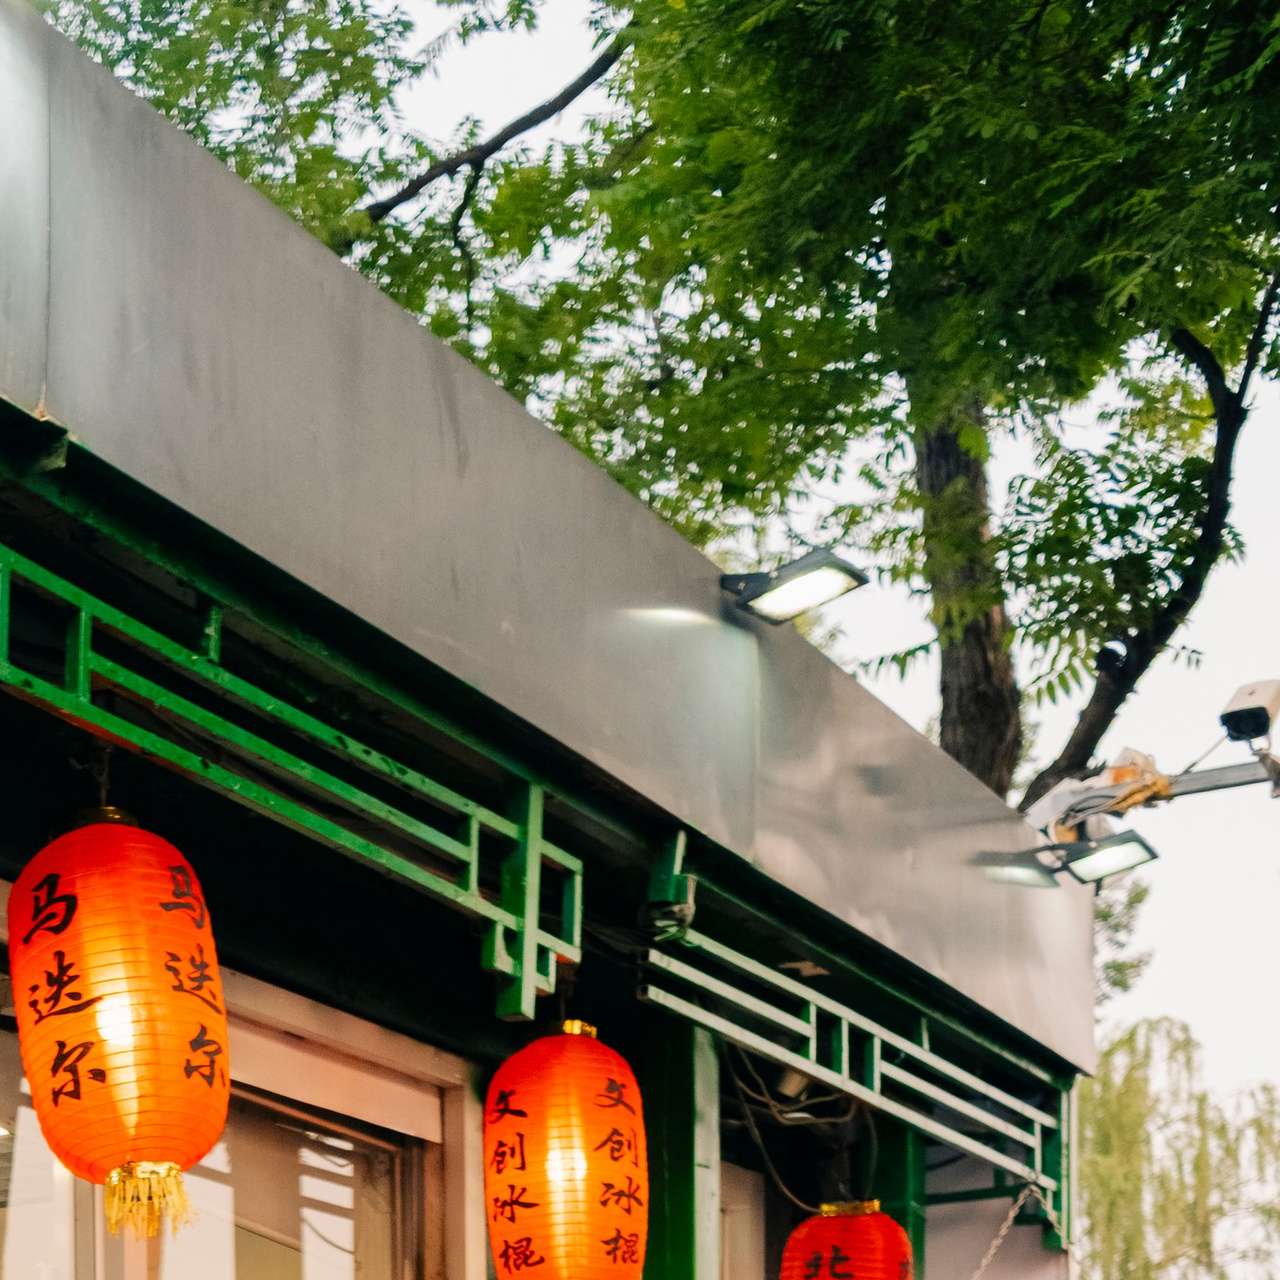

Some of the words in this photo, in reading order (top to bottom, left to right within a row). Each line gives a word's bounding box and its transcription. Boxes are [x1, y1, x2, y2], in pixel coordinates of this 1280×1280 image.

[23, 873, 107, 1106] 马迭尔
[159, 865, 227, 1089] 马迭尔
[488, 1089, 545, 1274] 文创冰棍
[594, 1077, 643, 1265] 文创冰棍
